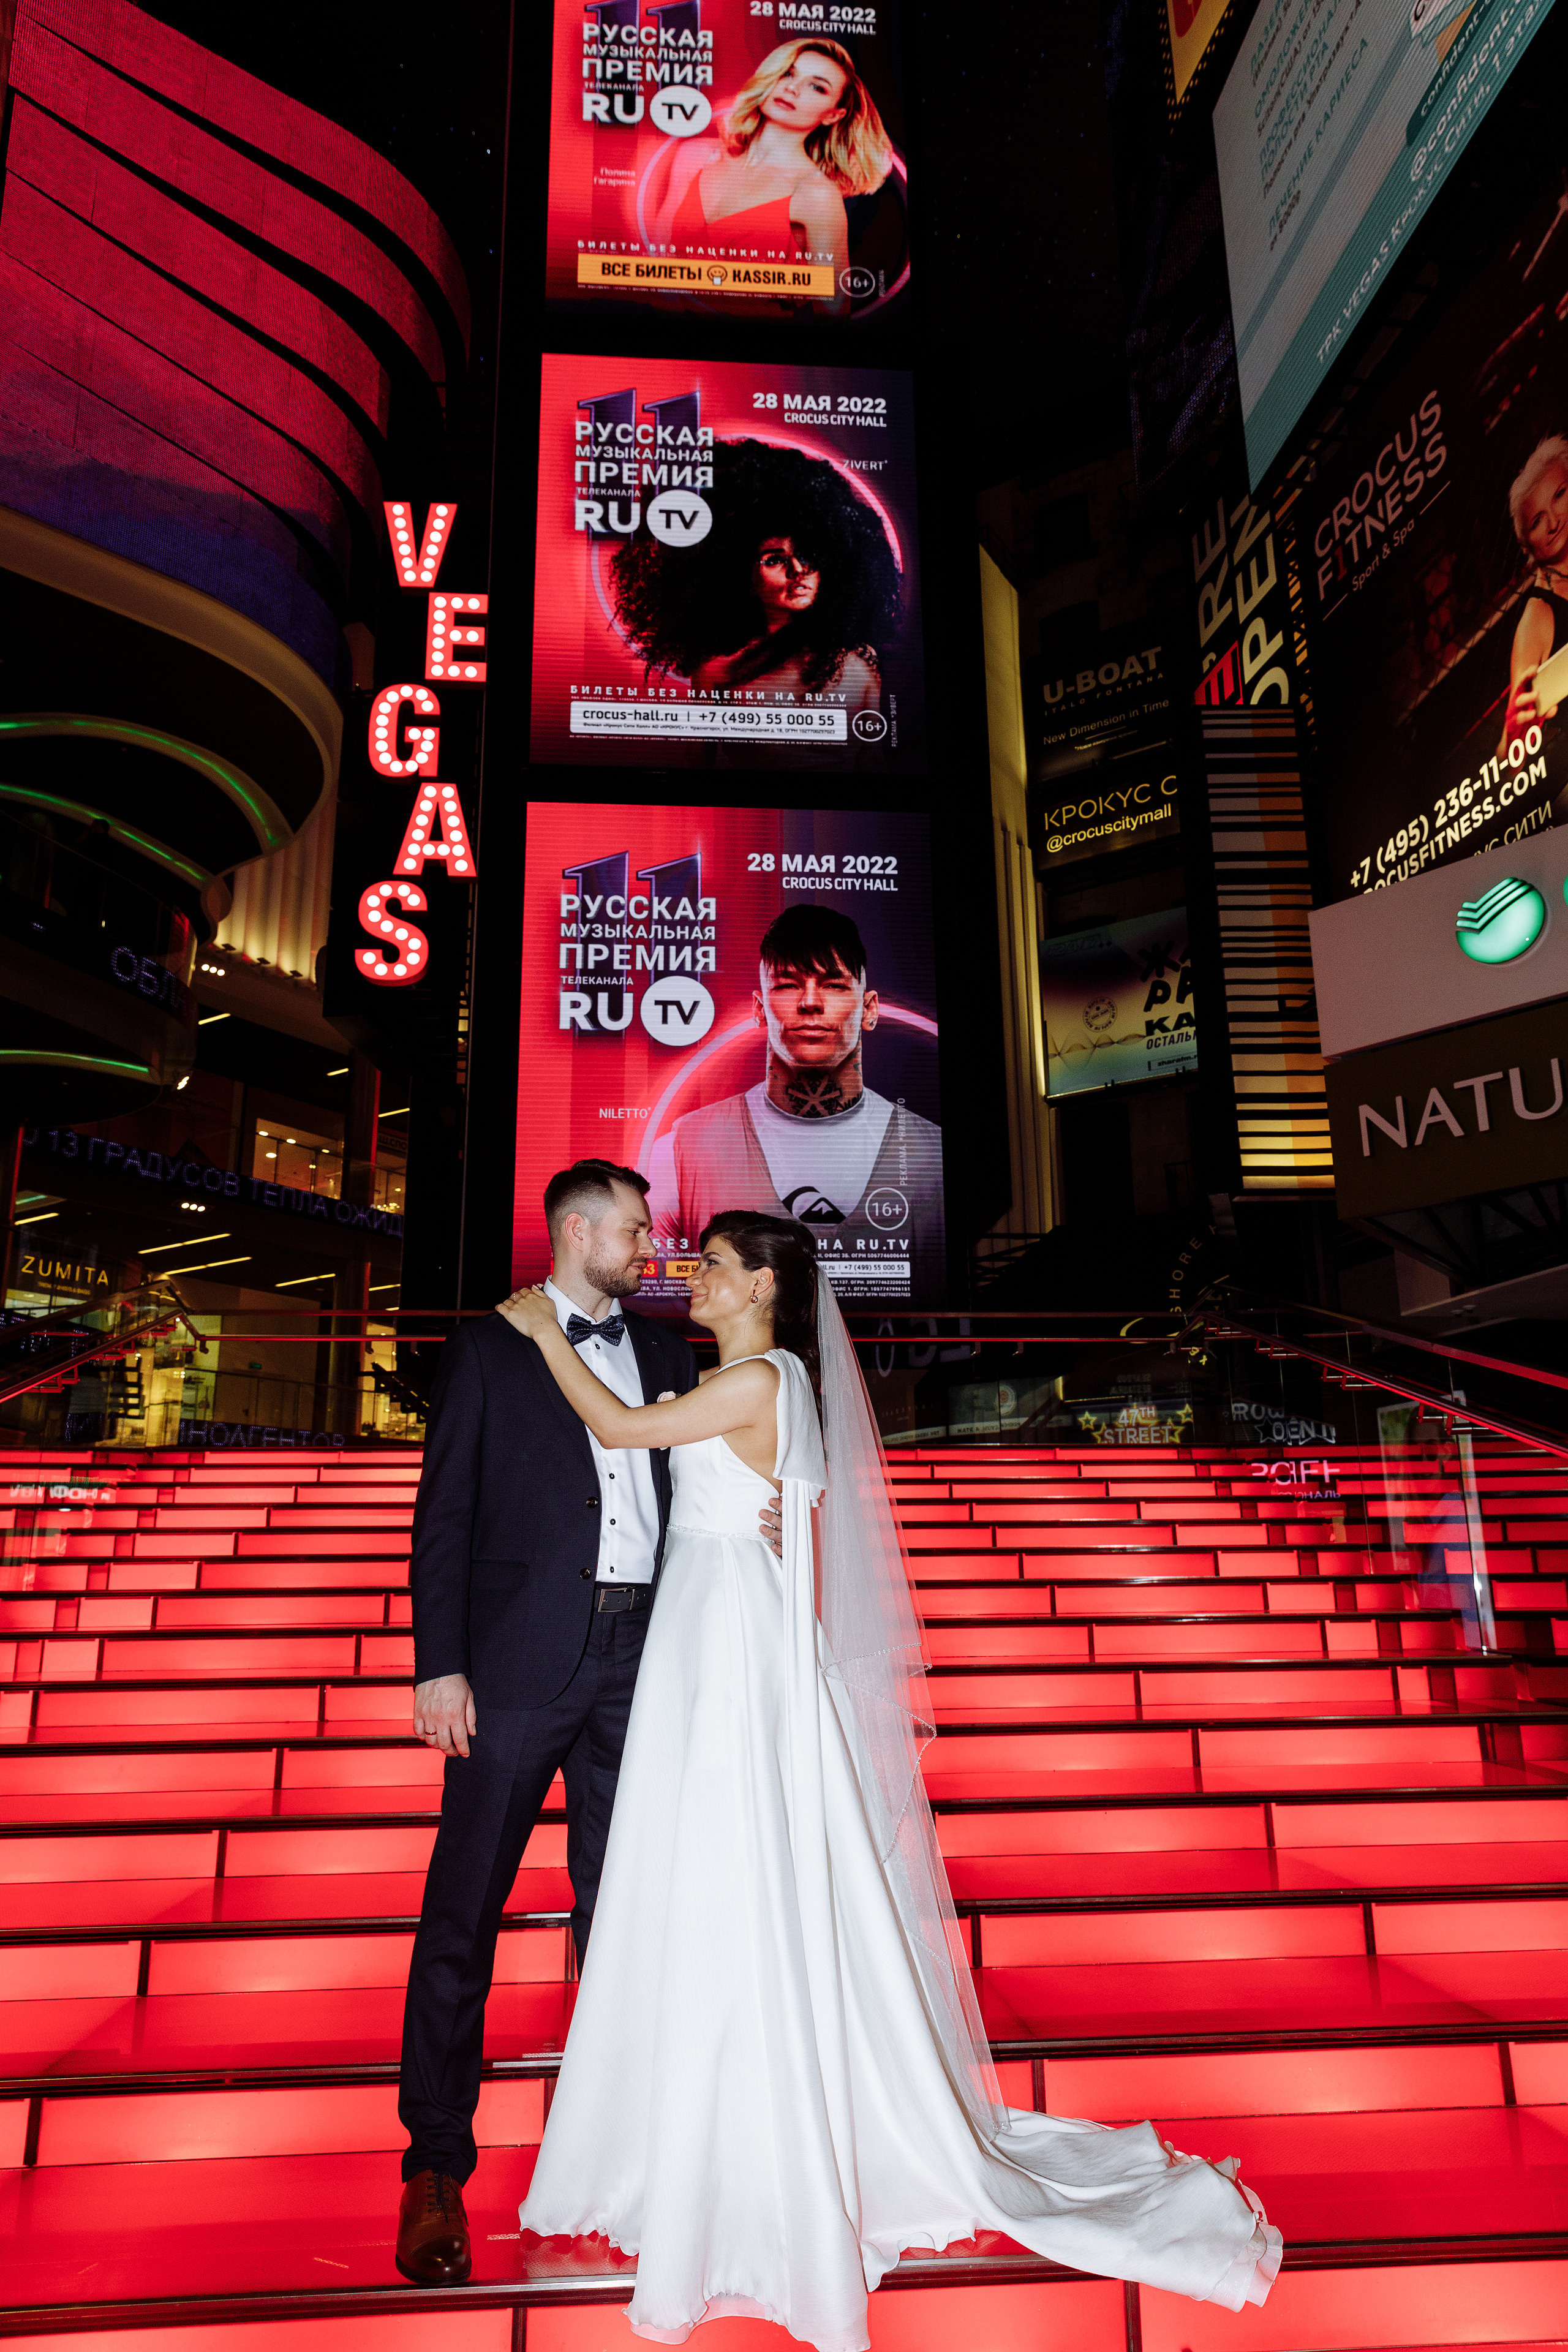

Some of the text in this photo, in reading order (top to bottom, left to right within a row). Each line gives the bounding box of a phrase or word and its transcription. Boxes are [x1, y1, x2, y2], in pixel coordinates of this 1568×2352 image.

[750, 1, 876, 23] 28 МАЯ 2022
[582, 22, 713, 49] РУССКАЯ
[779, 19, 876, 36] CROCUS CITY HALL
[582, 43, 712, 63] МУЗЫКАЛЬНАЯ
[582, 58, 713, 86] ПРЕМИЯ
[584, 81, 644, 91] ТЕЛЕКАНАЛА
[582, 92, 699, 124] RU TV
[578, 240, 640, 252] БИЛЕТЫ
[649, 243, 676, 253] БЕЗ
[686, 246, 758, 258] НАЦЕНКИ
[767, 250, 786, 259] НА
[795, 252, 834, 262] RU.TV
[601, 262, 811, 286] ВСЕ БИЛЕТЫ KASSIR.RU
[846, 276, 869, 288] 16+
[752, 392, 887, 414] 28 МАЯ 2022
[784, 412, 887, 428] CROCUS CITY HALL
[575, 421, 714, 447] РУССКАЯ
[575, 444, 713, 462] МУЗЫКАЛЬНАЯ
[575, 461, 714, 488] ПРЕМИЯ
[1314, 390, 1442, 558] CROCUS
[576, 487, 641, 497] ТЕЛЕКАНАЛА
[575, 499, 699, 533] RU TV
[1352, 518, 1415, 592] Sport & Spa
[1042, 646, 1162, 704] U-BOAT
[570, 685, 638, 696] БИЛЕТЫ
[648, 687, 677, 698] БЕЗ
[687, 689, 766, 701] НАЦЕНКИ
[775, 692, 795, 701] НА
[805, 693, 846, 703] RU.TV
[1044, 672, 1165, 717] ITALO FONTANA
[583, 709, 835, 726] crocus-hall.ru +7 (499) 55 000 55
[858, 720, 882, 731] 16+
[1043, 731, 1066, 745] New
[1069, 712, 1126, 738] Dimension
[1129, 707, 1139, 720] in
[1142, 698, 1170, 714] Time
[354, 500, 489, 987] VEGAS
[1044, 783, 1152, 831] КРОКУС
[1350, 725, 1542, 888] +7 (495) 236-11-00
[1046, 802, 1172, 854] @crocuscitymall
[747, 853, 898, 874] 28 МАЯ 2022
[782, 876, 898, 891] CROCUS CITY HALL
[560, 894, 716, 921] РУССКАЯ
[560, 922, 715, 940] МУЗЫКАЛЬНАЯ
[559, 943, 716, 971] ПРЕМИЯ
[561, 976, 633, 986] ТЕЛЕКАНАЛА
[559, 990, 700, 1031] RU TV
[1359, 1058, 1564, 1156] NATU
[47, 1128, 80, 1159] 13
[87, 1136, 241, 1197] ГРАДУСОВ
[249, 1177, 328, 1215] ТЕПЛА
[872, 1202, 903, 1217] 16+
[652, 1238, 909, 1250] БЕЗ НА RU.TV
[21, 1254, 109, 1287] ZUMITA
[676, 1264, 690, 1273] ВСЕ
[1103, 1425, 1173, 1444] STREET
